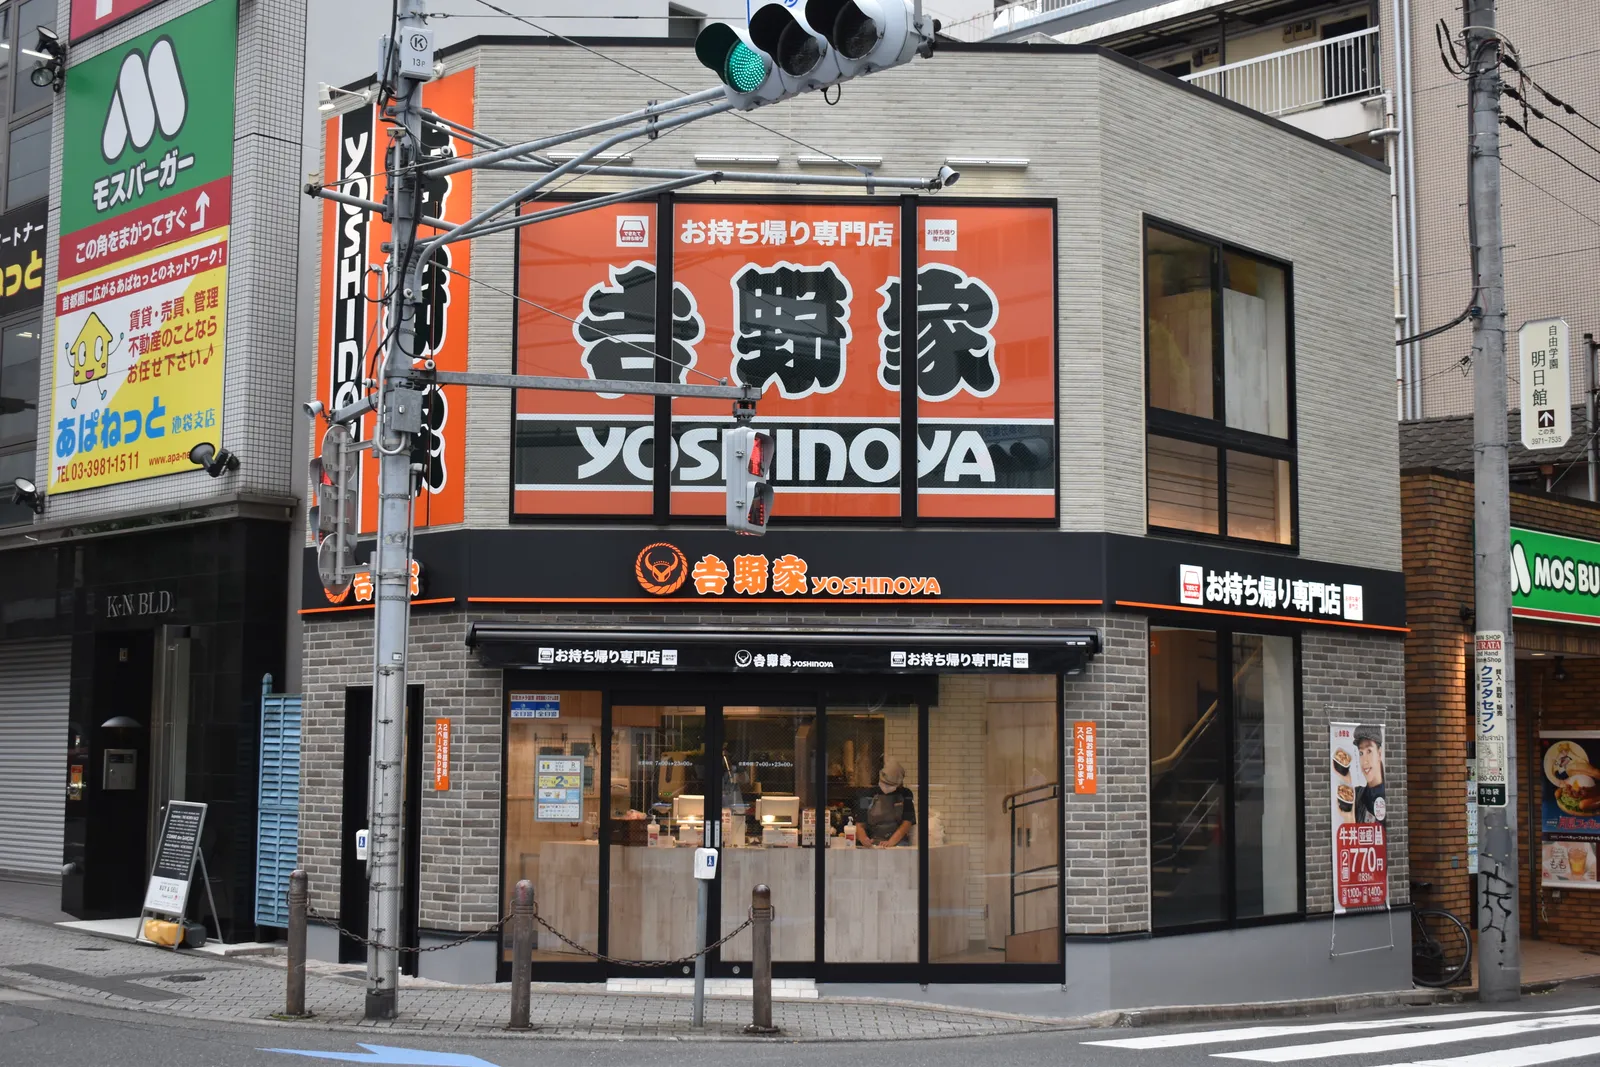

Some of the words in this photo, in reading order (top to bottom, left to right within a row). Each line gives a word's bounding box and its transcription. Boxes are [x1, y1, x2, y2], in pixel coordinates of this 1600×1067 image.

[92, 148, 195, 211] モスバーガー
[0, 222, 44, 248] ートナー
[75, 205, 188, 264] この角をまがってすぐ
[680, 219, 894, 249] お持ち帰り専門店
[0, 249, 43, 298] っと
[128, 286, 219, 332] 賃貸・売買、管理
[127, 315, 218, 358] 不動産のことなら
[572, 259, 1000, 402] 吉野家
[1548, 324, 1559, 370] 自由学園
[1531, 350, 1548, 407] 明日館
[56, 395, 166, 459] あぱねっと
[171, 408, 216, 435] 池袋支店
[1531, 435, 1563, 446] 3971-7535
[57, 465, 70, 484] TEL
[71, 450, 140, 481] 03-3981-1511
[148, 449, 191, 467] www.apa-ne
[692, 554, 808, 596] 吉野家
[811, 576, 941, 596] YOSHINOYA
[1205, 569, 1342, 616] お持ち帰り専門店
[1534, 555, 1576, 592] MOS
[1577, 562, 1600, 595] BU
[138, 590, 175, 615] BLD.
[554, 649, 661, 665] お持ち帰り専門店
[753, 653, 792, 668] 吉野家
[792, 660, 835, 668] YOSHINOYA
[906, 652, 1012, 668] お持ち帰り専門店
[1487, 656, 1502, 664] Shop
[1480, 664, 1496, 734] クラタセブン
[1482, 796, 1497, 804] 1-4
[1339, 826, 1358, 846] 牛丼
